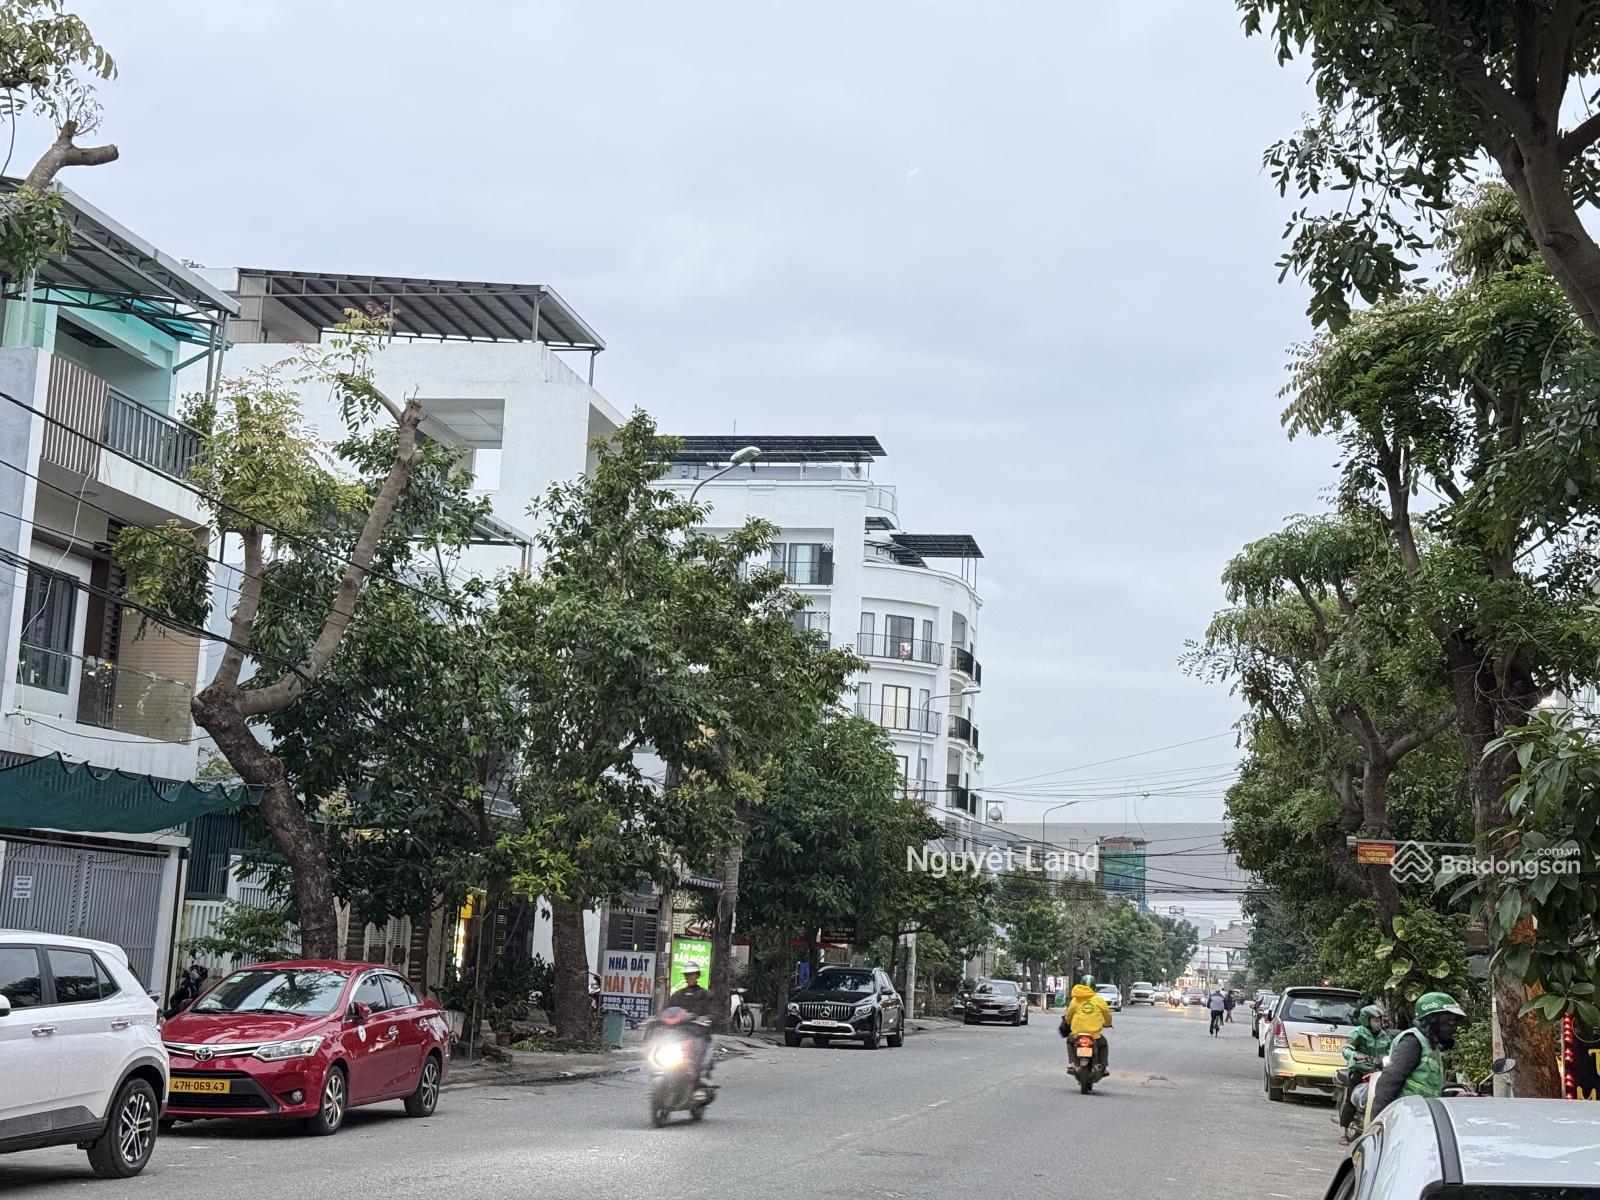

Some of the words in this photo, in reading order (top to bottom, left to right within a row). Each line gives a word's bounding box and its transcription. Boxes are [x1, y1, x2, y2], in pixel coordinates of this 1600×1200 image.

[608, 955, 628, 970] NHÀ
[630, 954, 650, 972] ĐẤT
[604, 972, 625, 993] HẢI
[629, 973, 652, 994] YẾN
[173, 1080, 225, 1091] 47H-069.43
